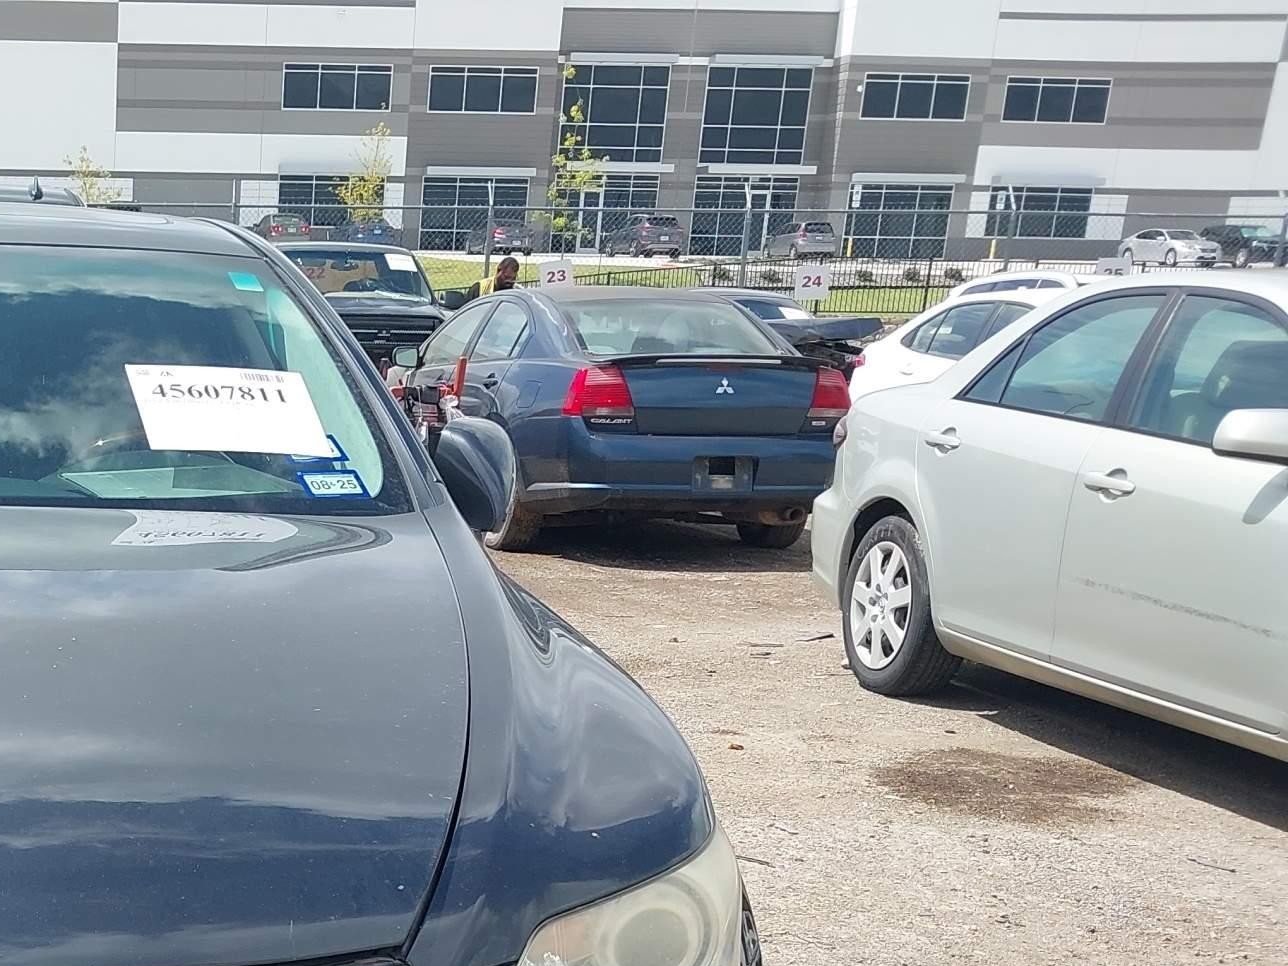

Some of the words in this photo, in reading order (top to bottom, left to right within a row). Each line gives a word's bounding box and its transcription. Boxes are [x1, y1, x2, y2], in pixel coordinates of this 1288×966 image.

[547, 270, 567, 283] 23
[802, 275, 823, 288] 24
[152, 383, 287, 403] 45607811
[310, 480, 331, 490] 08
[336, 479, 358, 490] 25
